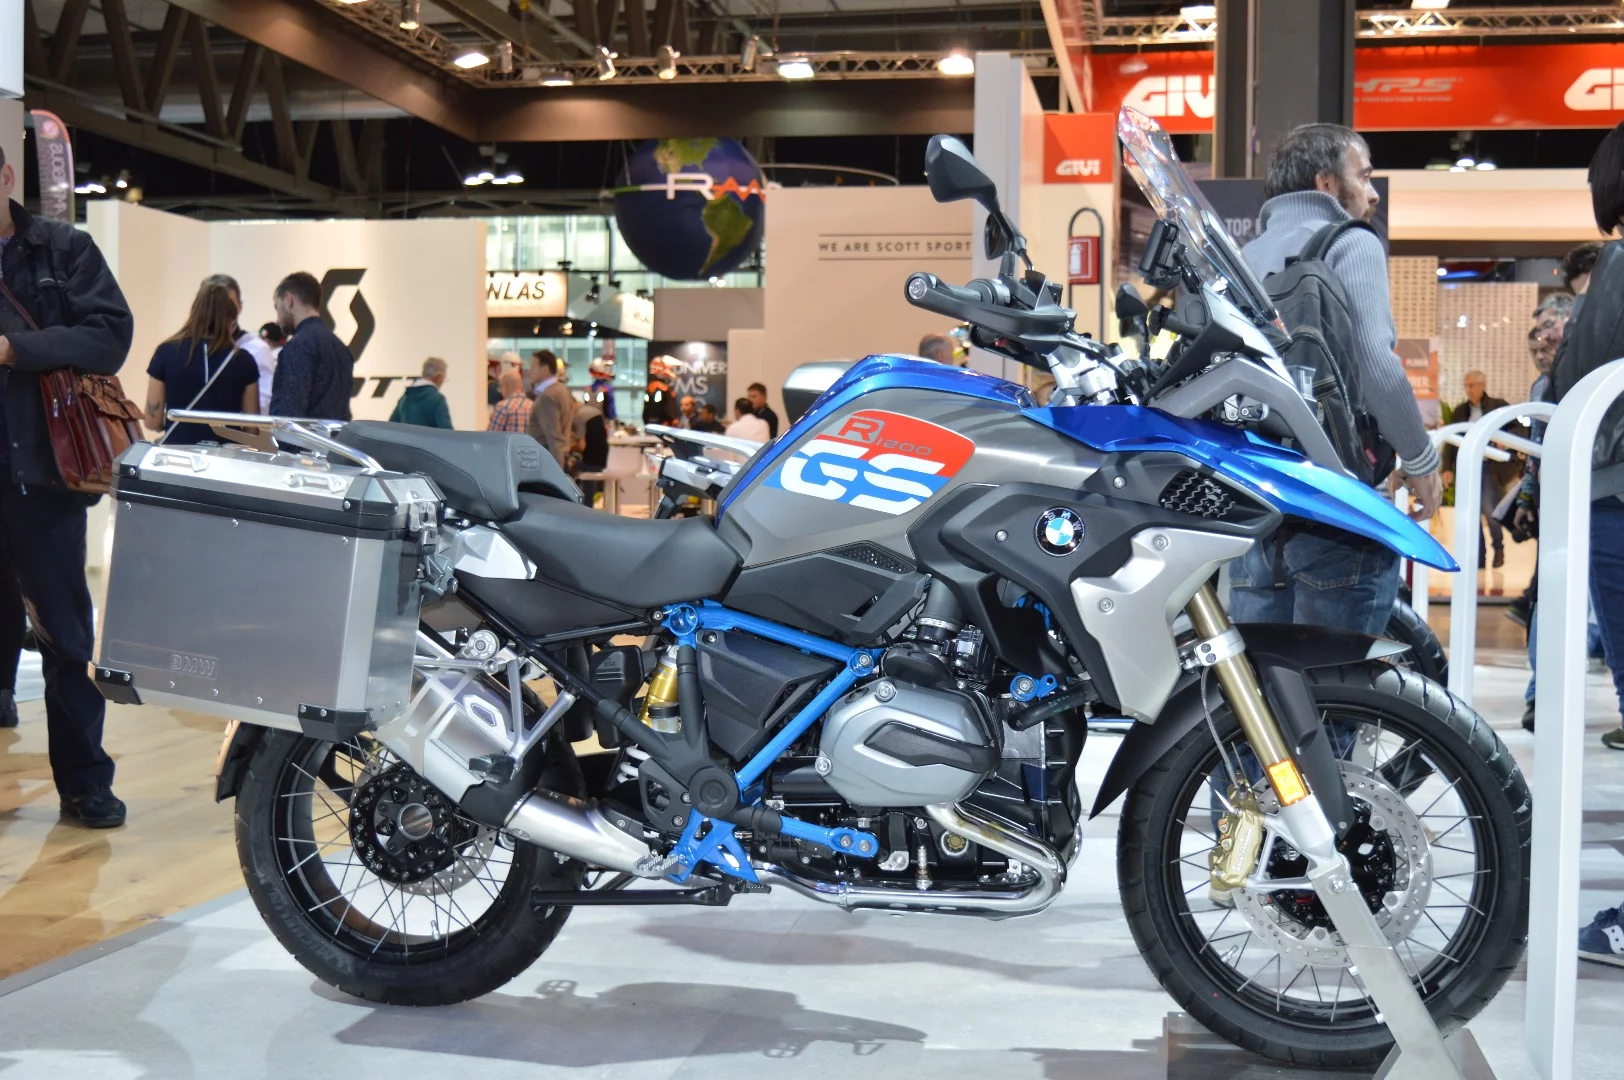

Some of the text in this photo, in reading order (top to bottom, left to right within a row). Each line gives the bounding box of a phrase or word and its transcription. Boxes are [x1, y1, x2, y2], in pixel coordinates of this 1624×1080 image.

[1563, 68, 1624, 110] GI
[1055, 159, 1100, 176] GIVI
[1225, 218, 1252, 236] TOP
[819, 241, 972, 252] WE ARE SCOTT SPORT
[838, 418, 932, 456] R 1200
[780, 439, 946, 515] GS
[1044, 510, 1082, 531] BMW
[171, 653, 216, 676] BMW
